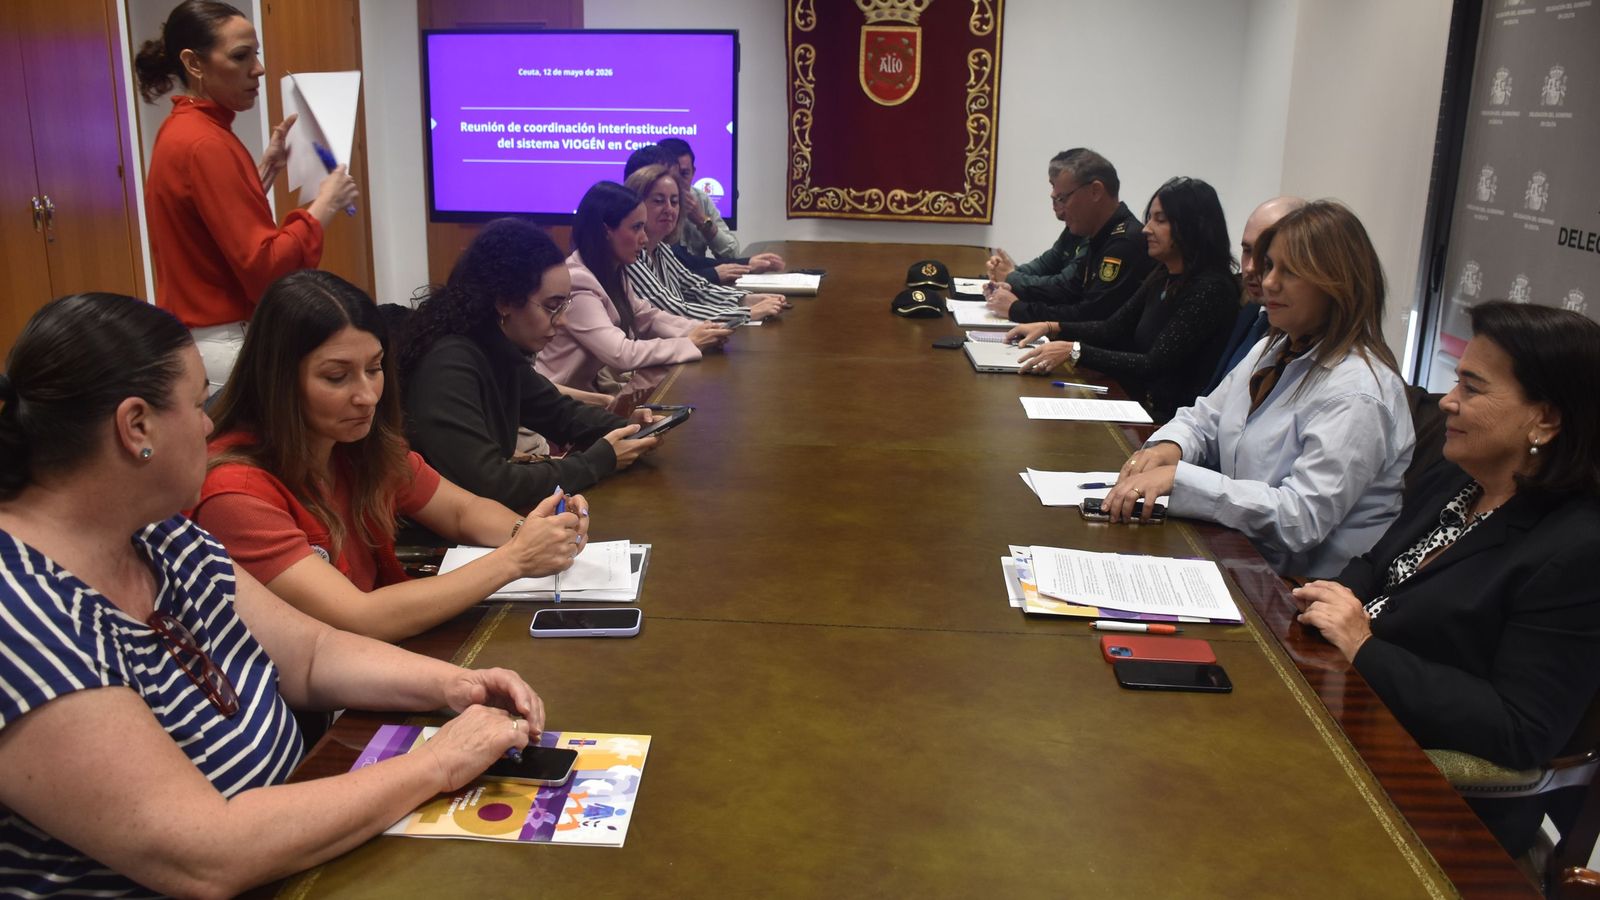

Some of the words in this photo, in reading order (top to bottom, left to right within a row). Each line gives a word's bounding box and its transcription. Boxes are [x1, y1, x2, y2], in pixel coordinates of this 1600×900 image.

[518, 68, 541, 77] Ceuta,
[553, 68, 561, 76] de
[563, 69, 583, 78] mayo
[585, 68, 594, 76] de
[596, 68, 613, 76] 2026
[460, 121, 504, 133] Reunión
[507, 121, 521, 133] de
[523, 121, 595, 134] coordinación
[598, 122, 697, 136] interinstitucional
[497, 137, 514, 149] del
[516, 137, 559, 150] sistema
[562, 137, 605, 150] VIOGÉN
[608, 141, 622, 150] en
